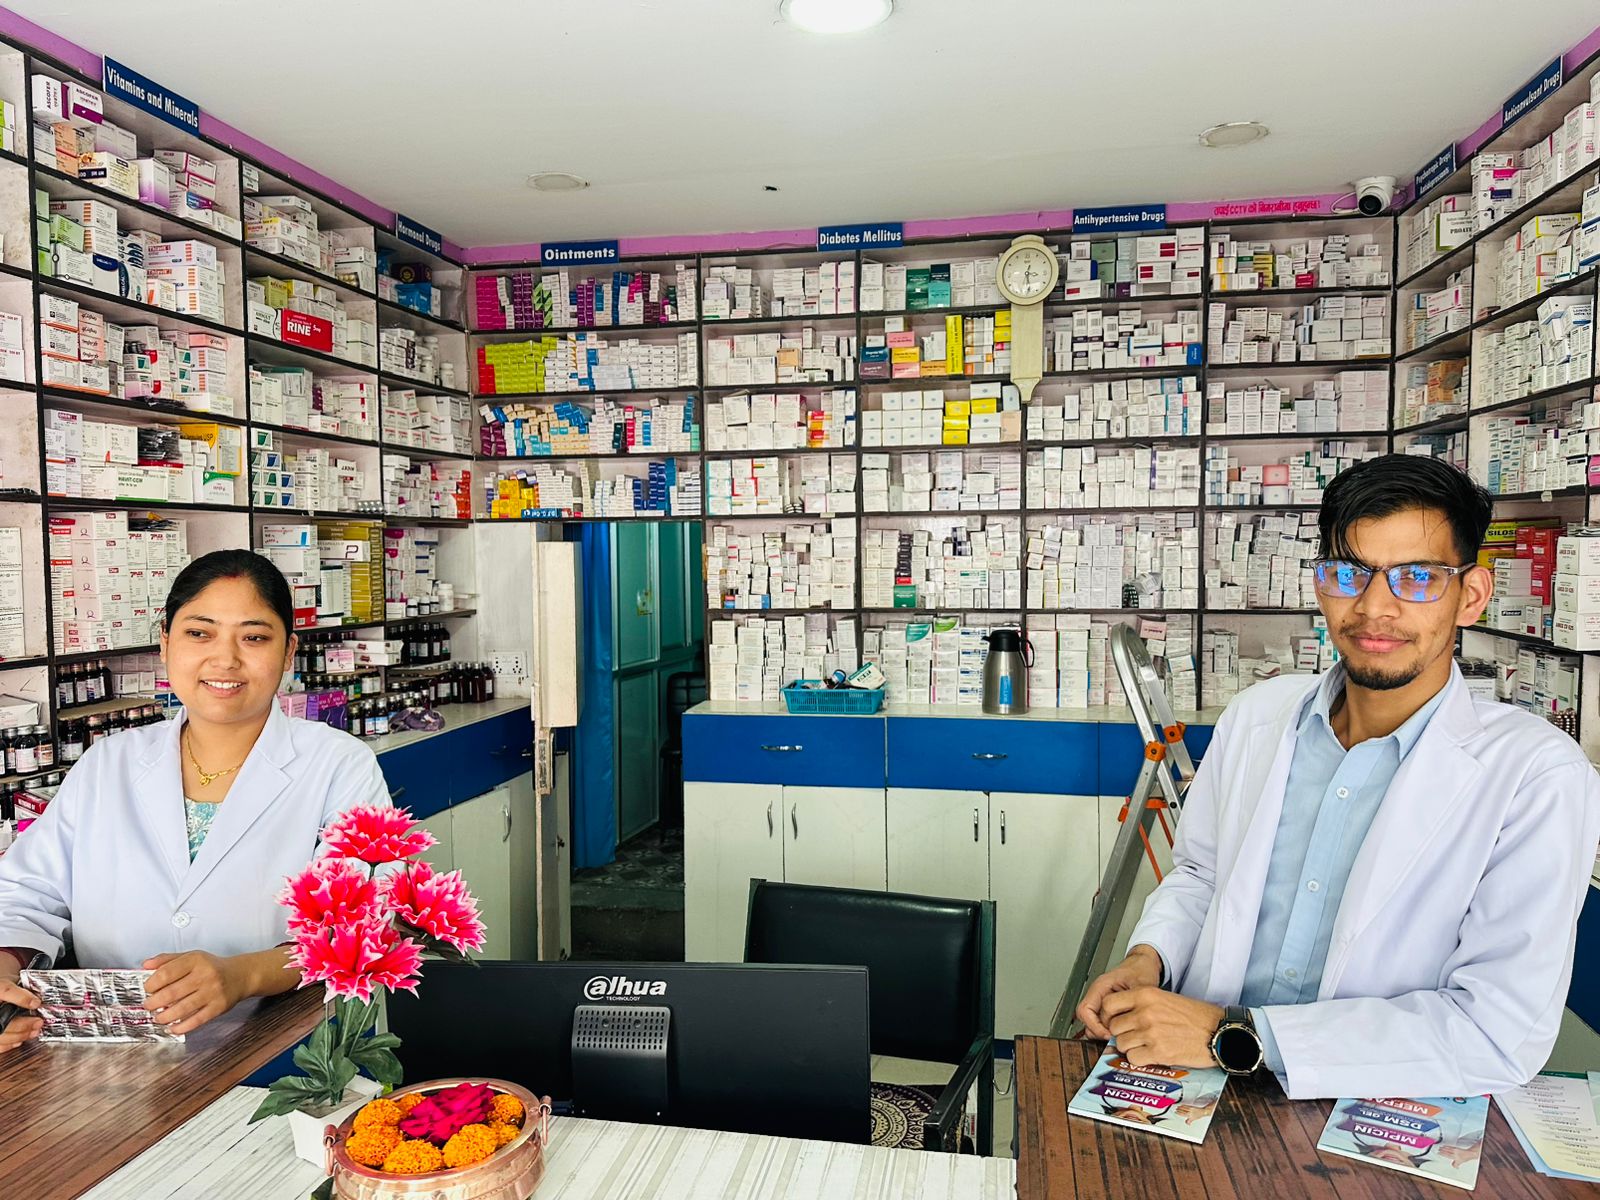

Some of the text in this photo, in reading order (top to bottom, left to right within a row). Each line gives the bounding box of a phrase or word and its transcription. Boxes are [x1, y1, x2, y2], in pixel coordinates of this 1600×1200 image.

[1543, 71, 1560, 92] Drugs
[107, 66, 198, 128] Vitamins and Minerals
[1074, 211, 1165, 226] Antihypertensive Drugs
[398, 220, 441, 252] Hormonal Drugs
[820, 229, 902, 245] Diabetes Mellitus
[544, 247, 616, 261] Ointments
[286, 321, 312, 337] RINE
[1487, 529, 1517, 537] SILOS
[1134, 1080, 1168, 1092] DSM
[1104, 1088, 1159, 1106] MPICIN
[1359, 1109, 1423, 1131] DSM GEL
[1354, 1124, 1417, 1146] MPICIN
